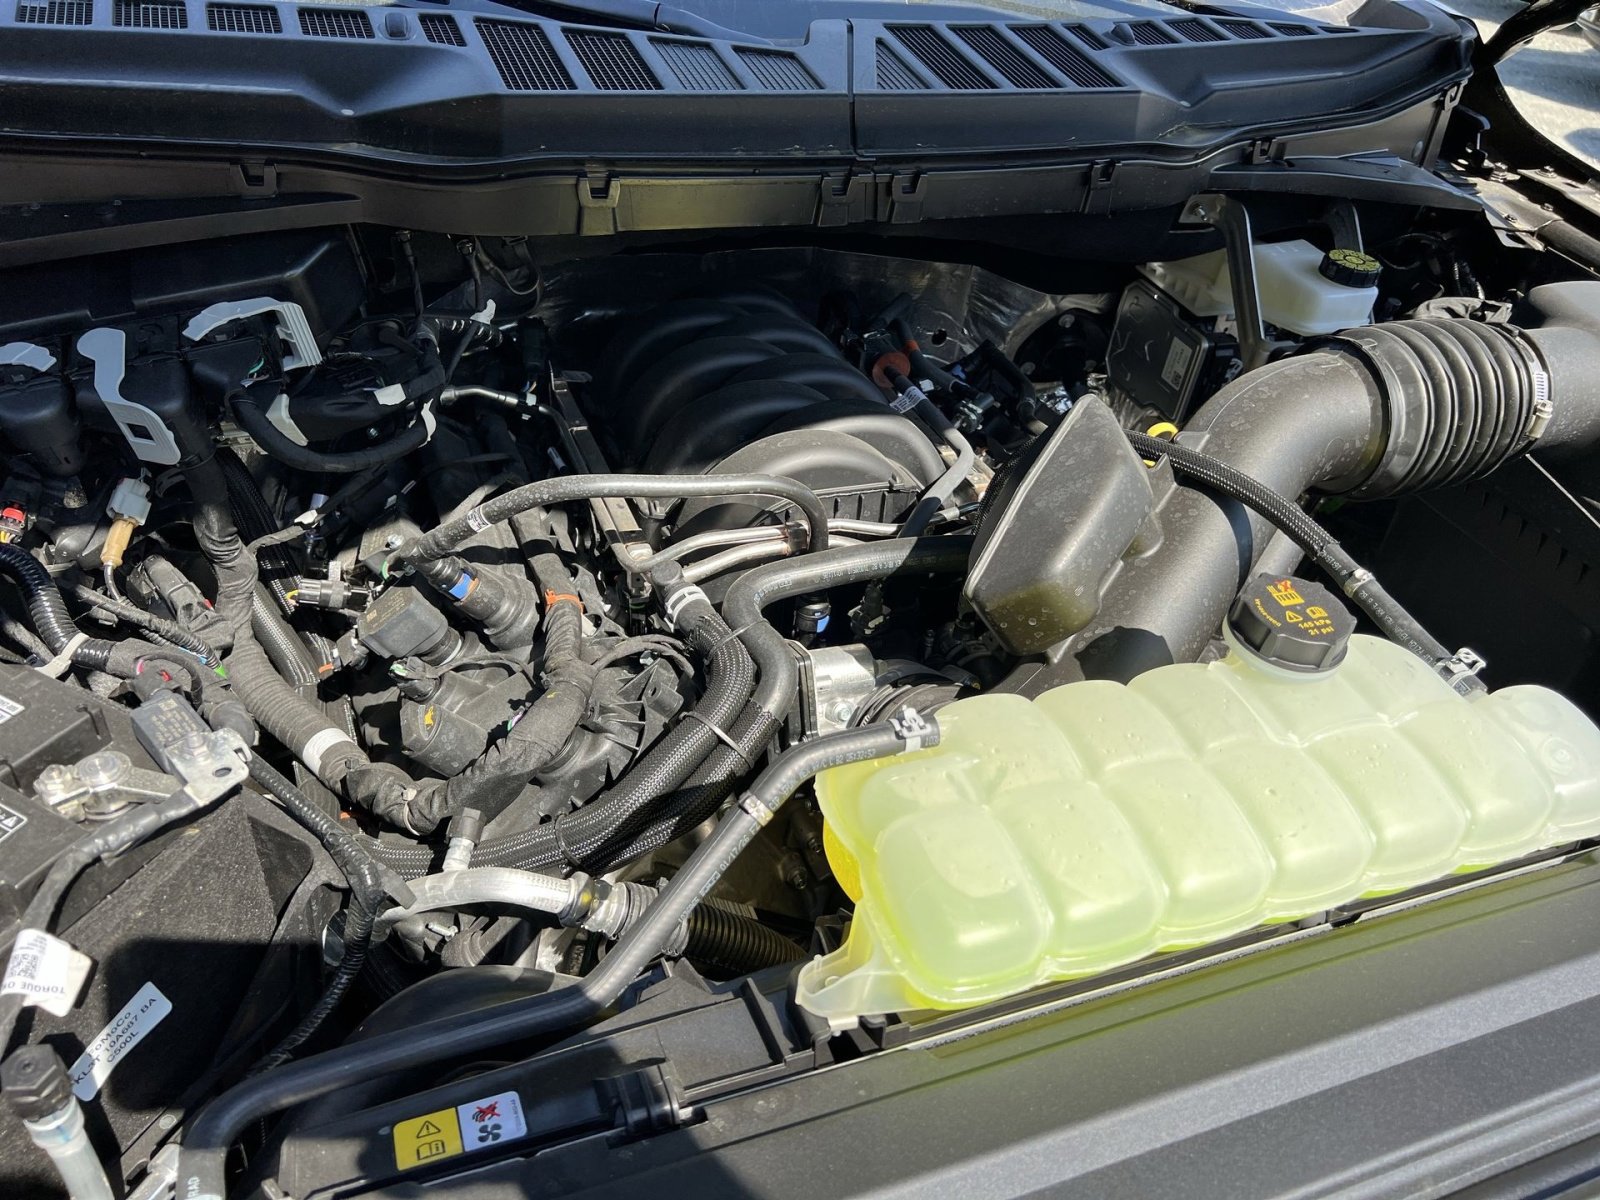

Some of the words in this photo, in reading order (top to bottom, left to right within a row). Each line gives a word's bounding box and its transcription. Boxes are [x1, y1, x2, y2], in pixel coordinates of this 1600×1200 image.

[1298, 621, 1314, 629] 145
[1321, 626, 1335, 635] psi
[719, 835, 751, 872] 01/17/26
[20, 981, 66, 994] TORQUE
[140, 998, 157, 1014] BA
[88, 1012, 131, 1057] FoMoCo
[107, 1031, 139, 1063] C500L
